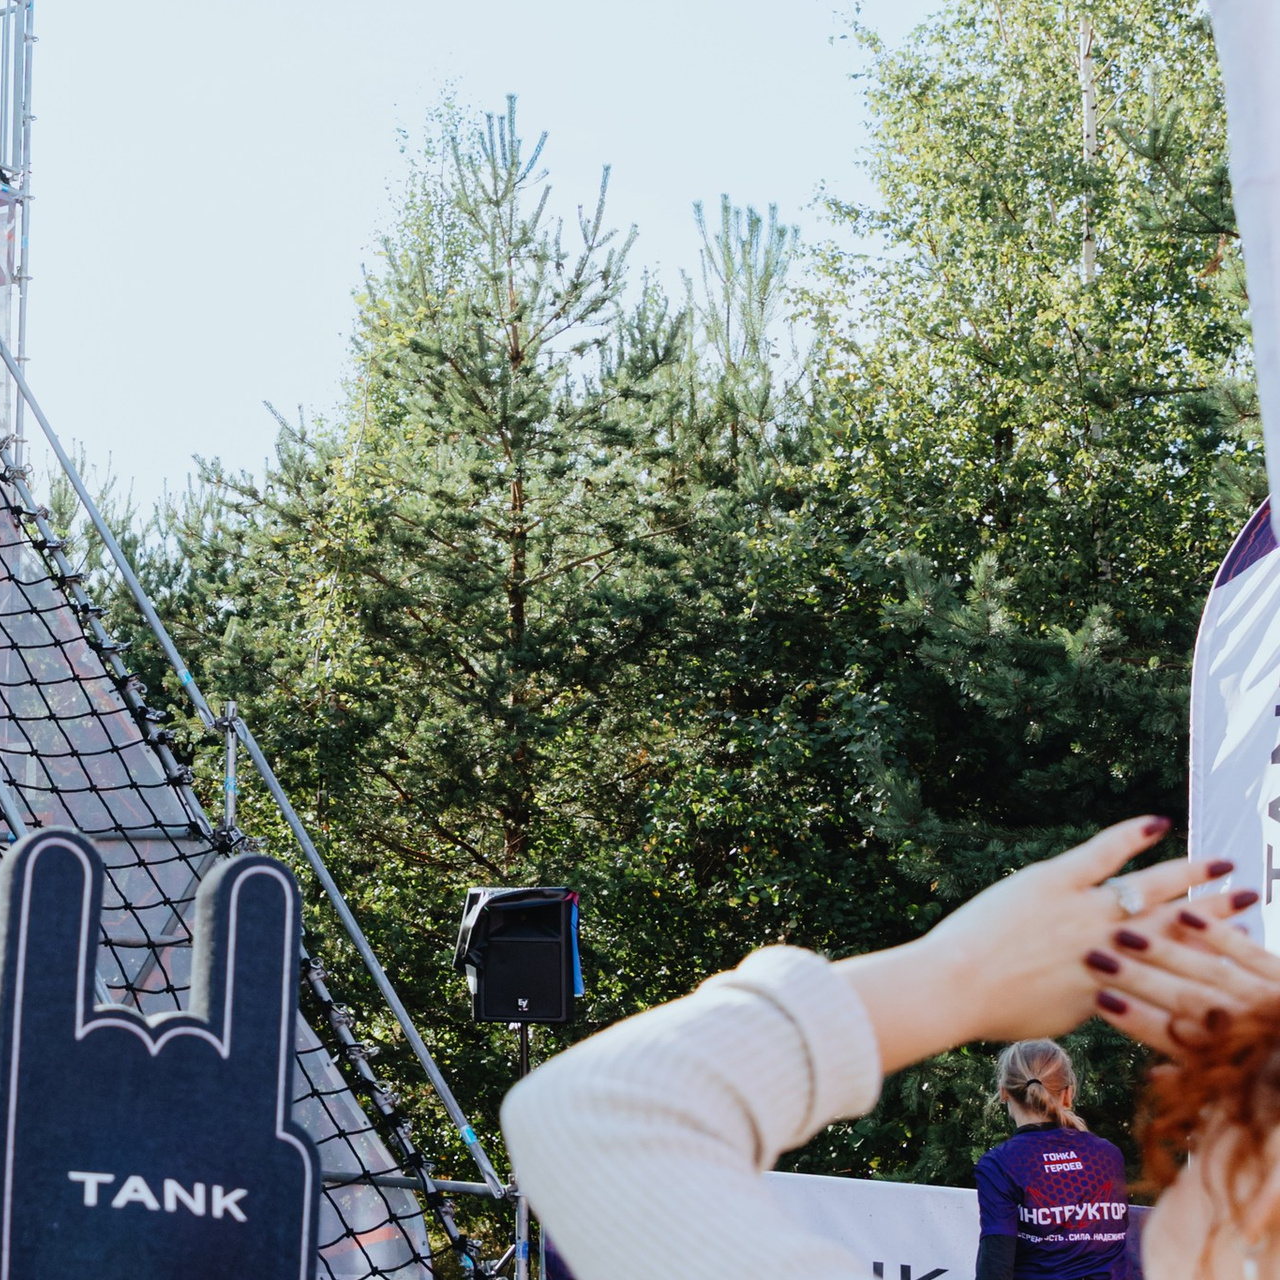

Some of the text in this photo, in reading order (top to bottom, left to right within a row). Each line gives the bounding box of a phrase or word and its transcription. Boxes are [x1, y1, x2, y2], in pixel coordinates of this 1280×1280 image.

[1043, 1150, 1078, 1162] ГОНКА
[1044, 1161, 1084, 1173] ГЕРОЕВ
[67, 1170, 249, 1223] TANK
[1068, 1233, 1091, 1241] СИЛА
